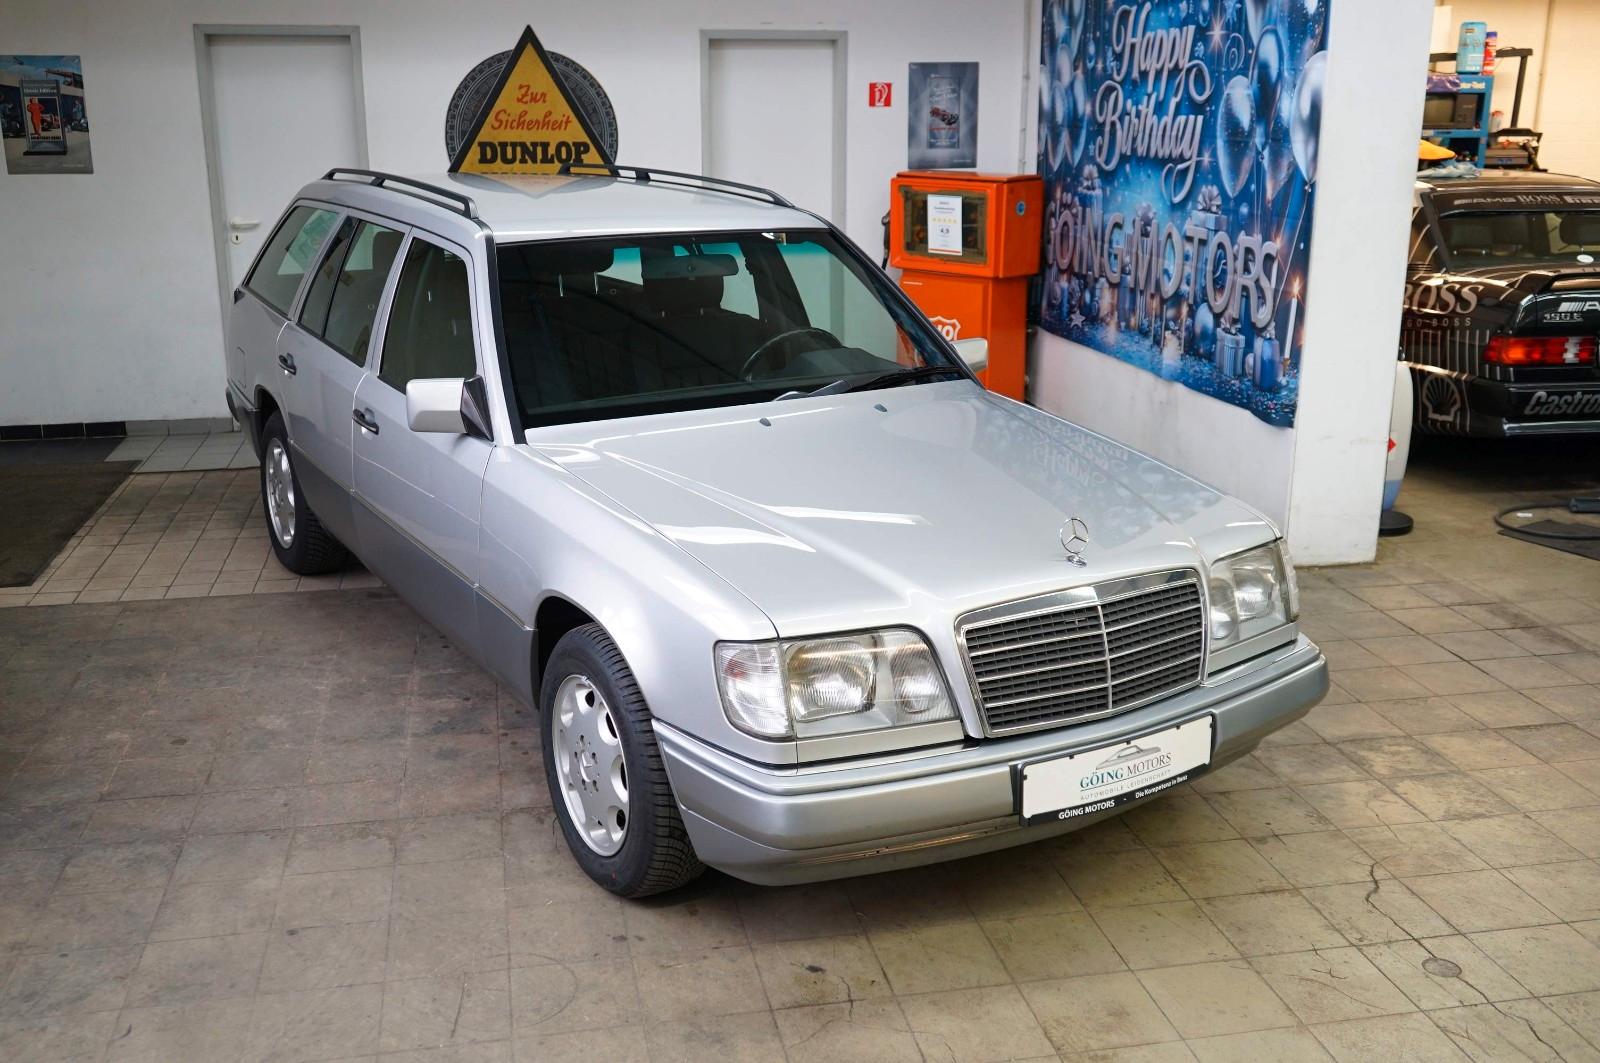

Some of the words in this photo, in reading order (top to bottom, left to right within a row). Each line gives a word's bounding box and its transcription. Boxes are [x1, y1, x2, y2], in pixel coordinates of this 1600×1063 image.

[1112, 3, 1214, 102] Happy
[516, 84, 548, 105] Zur
[490, 109, 572, 131] Sicherheit
[477, 141, 591, 165] DUNLOP
[1096, 80, 1205, 203] Birthday
[1129, 217, 1279, 329] MOTORS
[1432, 317, 1471, 327] BOSS
[1524, 391, 1600, 416] Castro
[1080, 770, 1124, 789] GÖING
[1127, 752, 1172, 777] MOTORS
[1058, 809, 1084, 820] GÖING
[1085, 799, 1115, 814] MOTORS
[1135, 790, 1145, 799] Die
